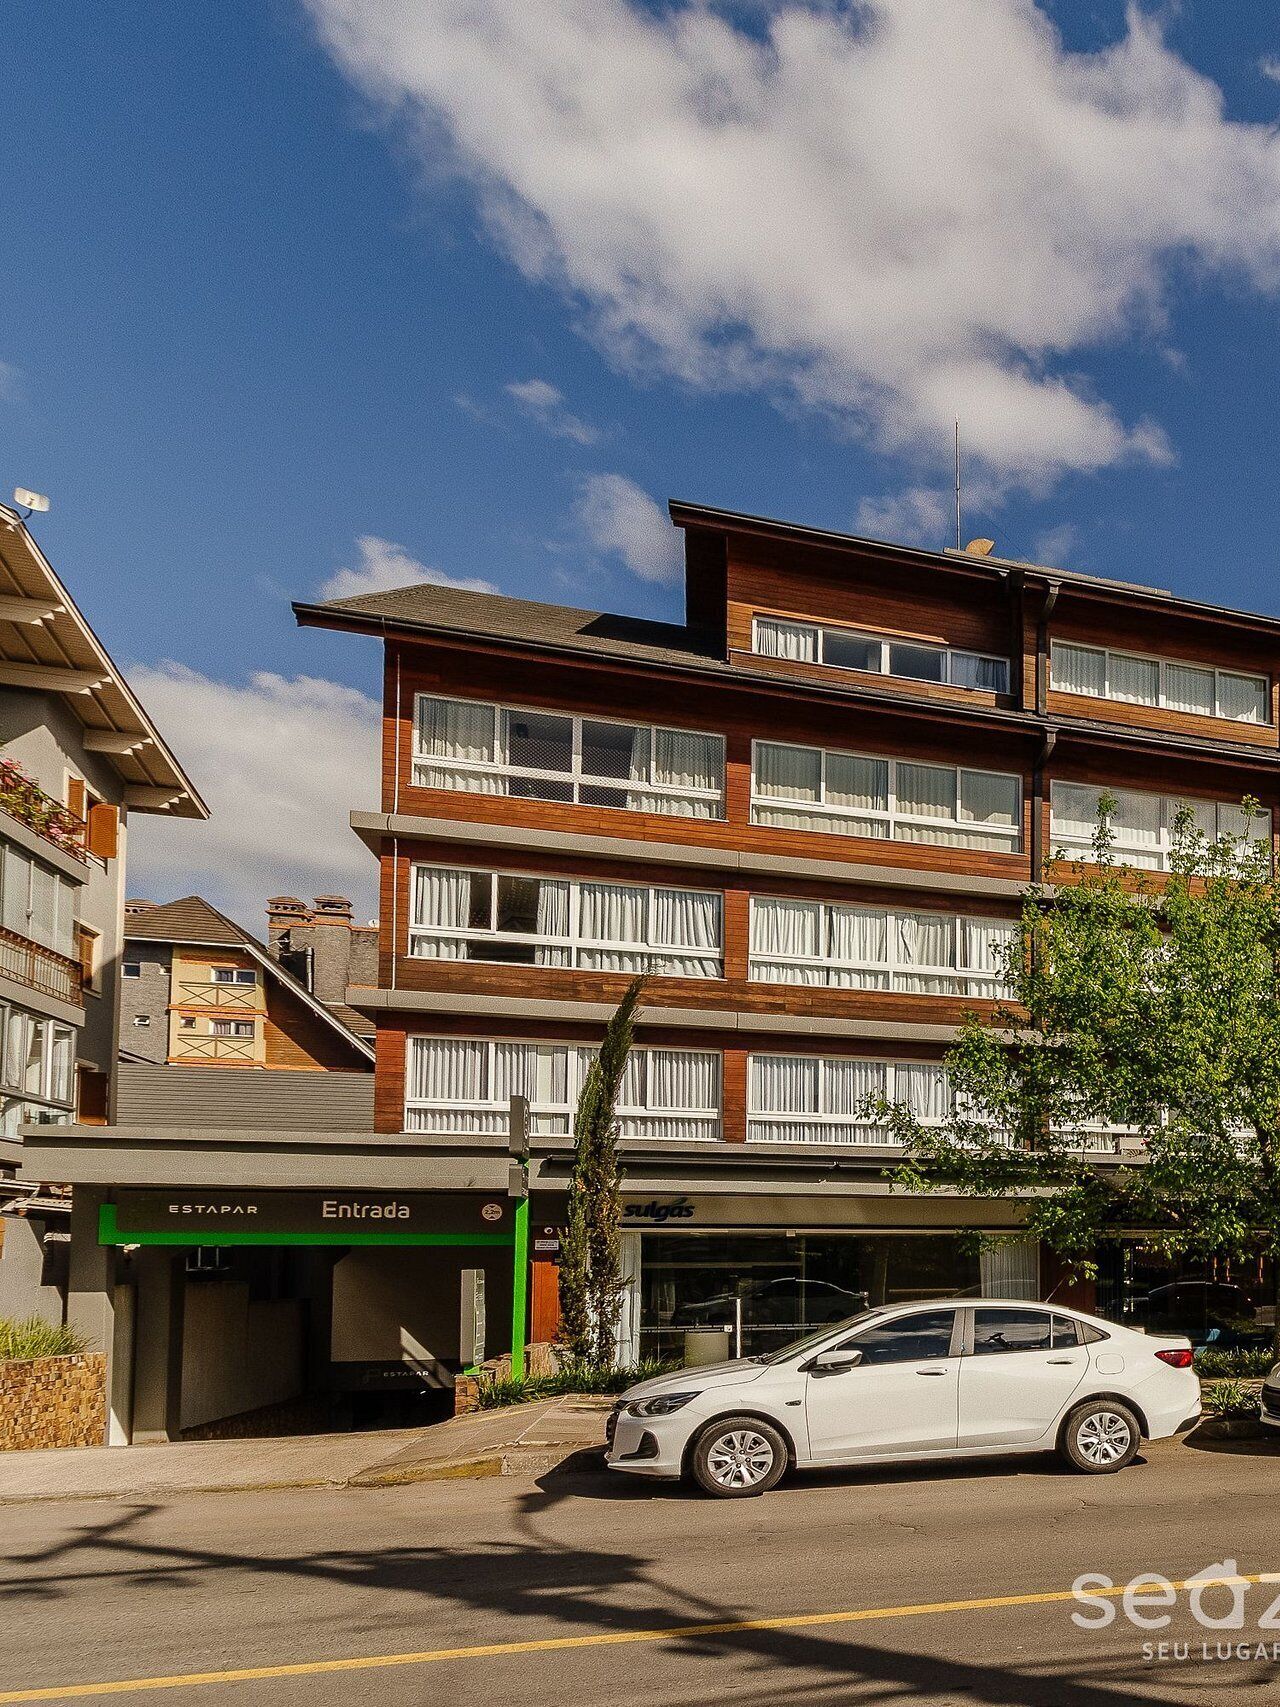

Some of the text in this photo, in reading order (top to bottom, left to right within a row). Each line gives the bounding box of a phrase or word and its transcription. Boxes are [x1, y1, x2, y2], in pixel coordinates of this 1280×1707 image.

[168, 1205, 258, 1214] ESTAPAR
[322, 1200, 410, 1219] Entrada
[623, 1197, 695, 1222] sulgás
